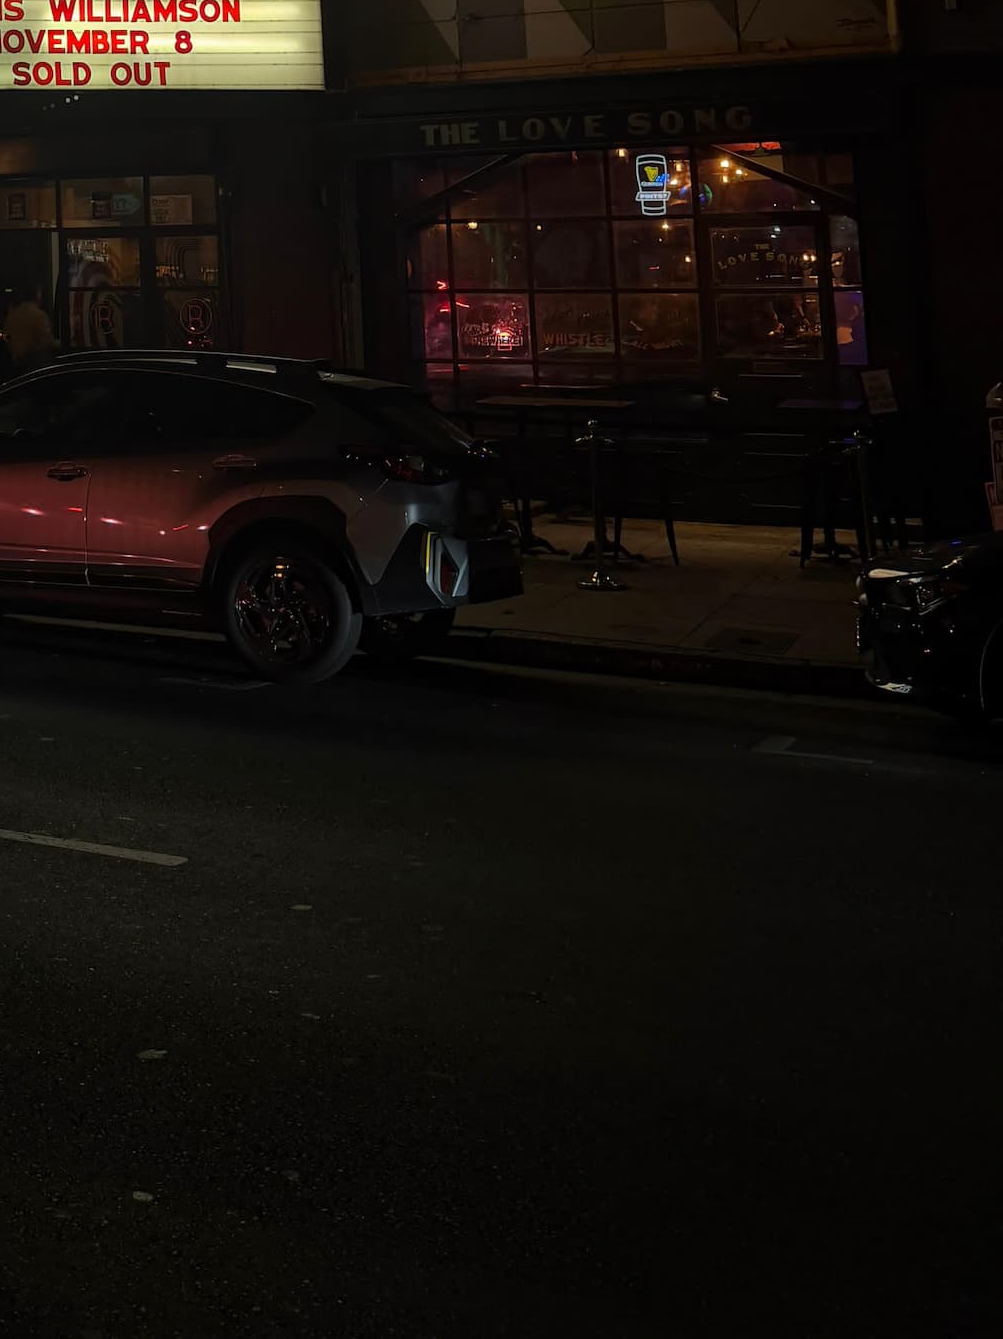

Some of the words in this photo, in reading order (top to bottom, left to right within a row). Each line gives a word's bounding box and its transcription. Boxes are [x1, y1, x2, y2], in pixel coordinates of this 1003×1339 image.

[174, 29, 194, 55] 8
[12, 61, 92, 87] SOLD
[110, 61, 171, 86] OUT
[419, 121, 481, 147] THE
[498, 114, 605, 142] LOVE
[627, 105, 753, 135] SONG
[717, 252, 760, 270] LOVE
